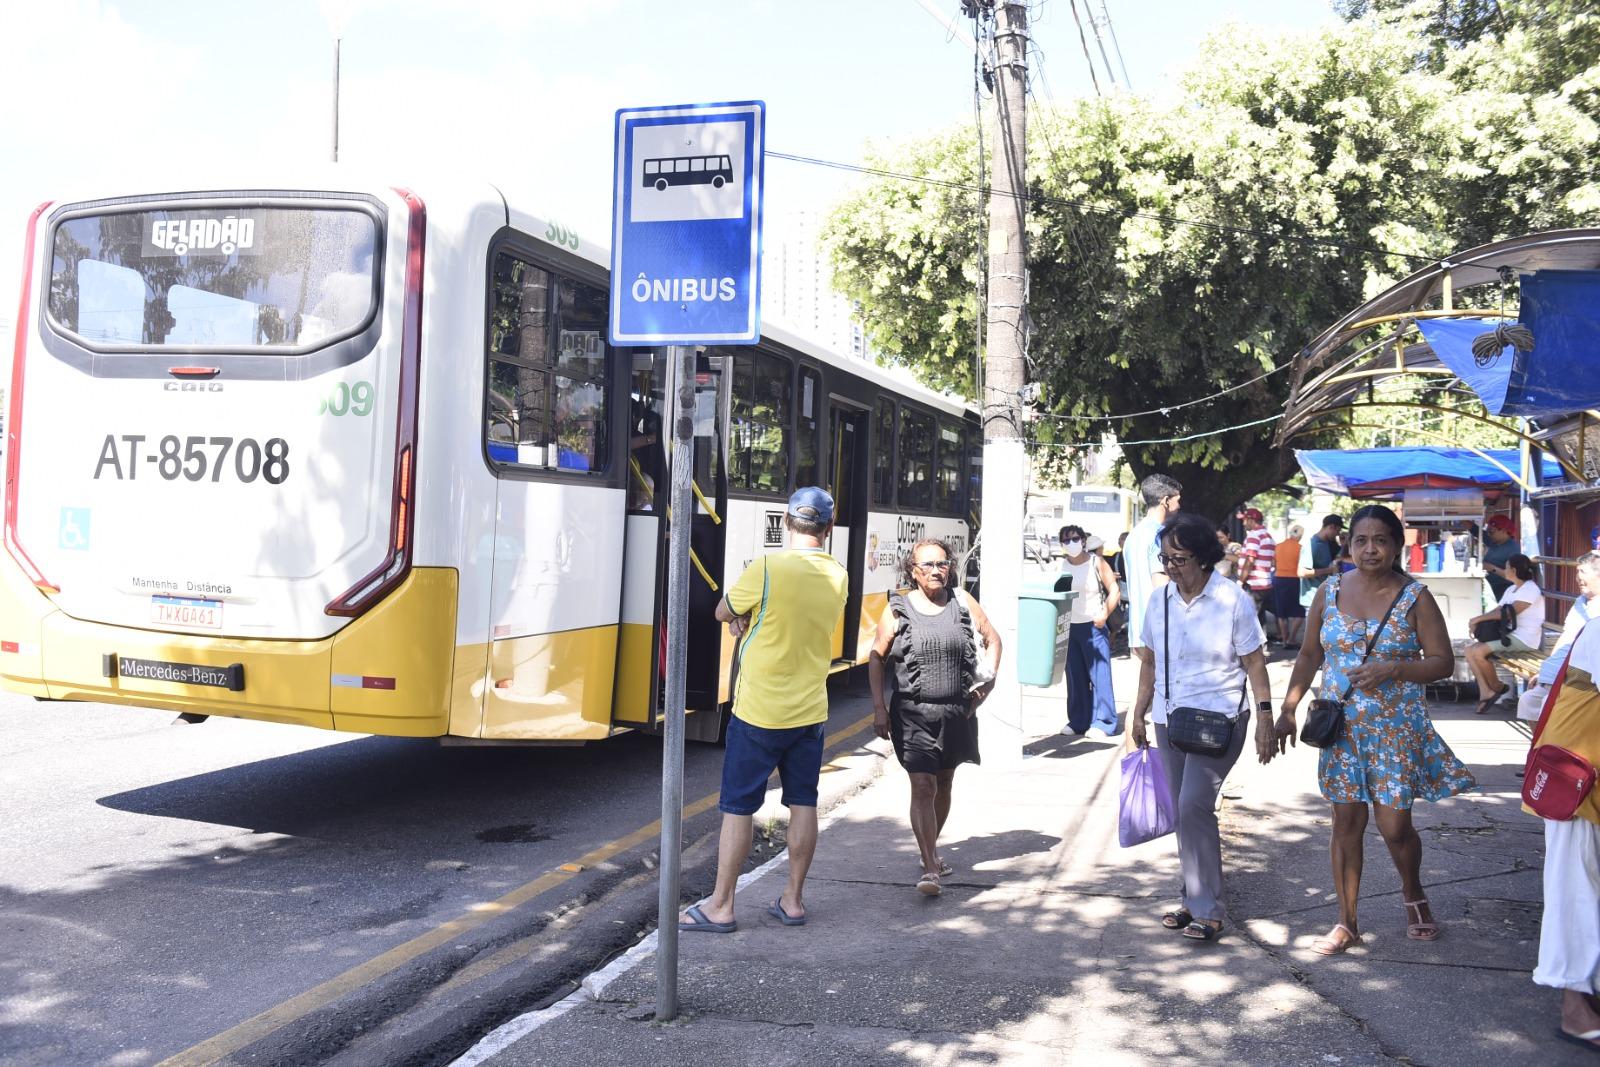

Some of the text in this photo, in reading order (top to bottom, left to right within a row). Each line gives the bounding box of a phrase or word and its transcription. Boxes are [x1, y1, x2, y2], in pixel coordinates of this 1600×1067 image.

[151, 215, 255, 255] GELADÃO
[631, 272, 736, 303] ÔNIBUS
[94, 433, 289, 485] AT-85708
[132, 576, 232, 594] Mantenha Distância
[124, 659, 226, 686] Mercedes-Benz
